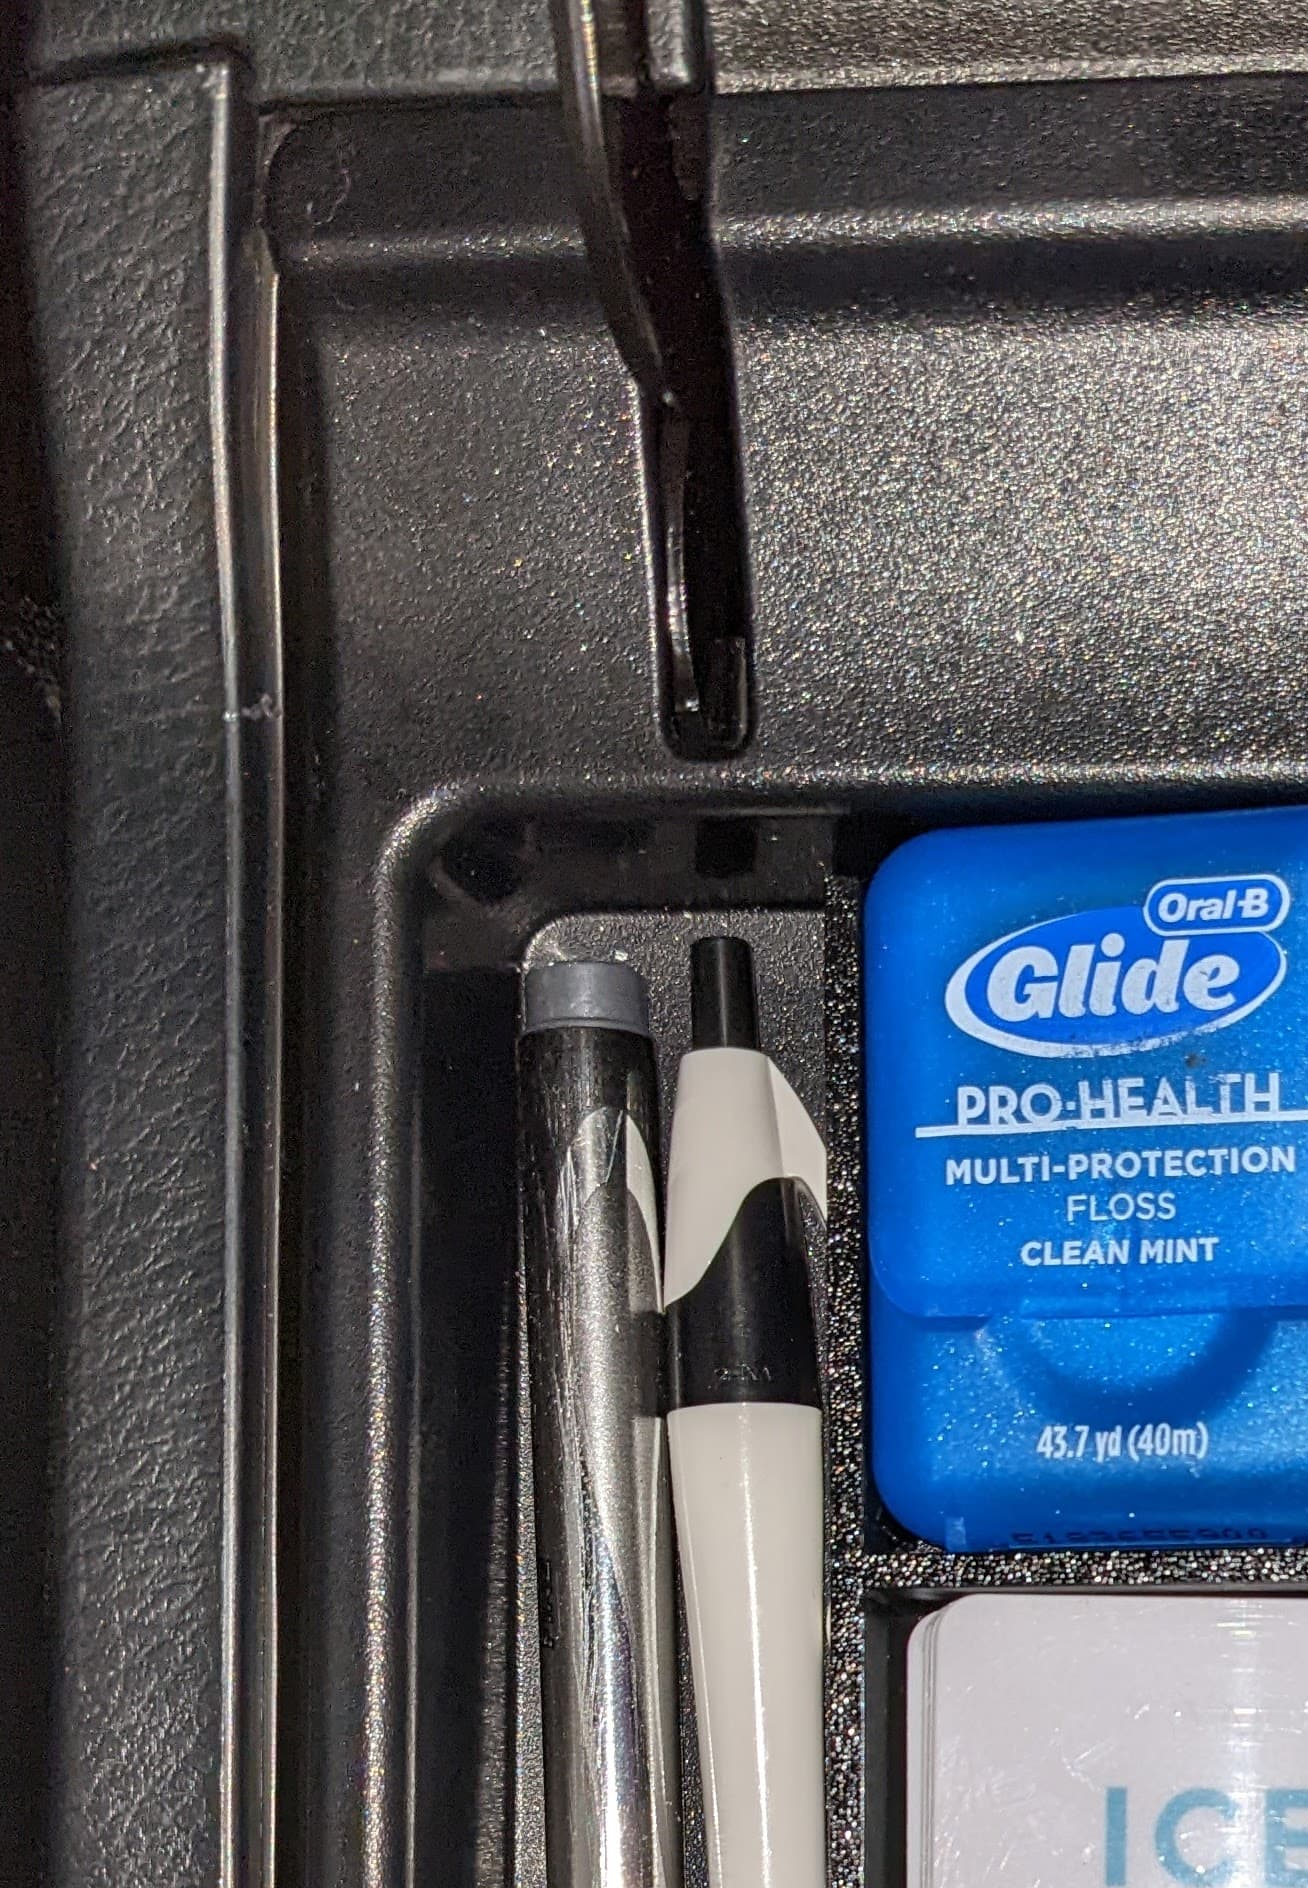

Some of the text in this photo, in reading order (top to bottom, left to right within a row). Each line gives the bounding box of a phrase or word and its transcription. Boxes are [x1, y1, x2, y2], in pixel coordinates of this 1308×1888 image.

[1157, 885, 1269, 923] Oral-B
[986, 932, 1240, 1022] Glide
[945, 1145, 1296, 1186] MULTI-PROTECTION
[1066, 1192, 1177, 1223] FLOSS
[1020, 1236, 1220, 1266] CLEAN MINT
[1036, 1422, 1209, 1460] 43.7 yd (40m)
